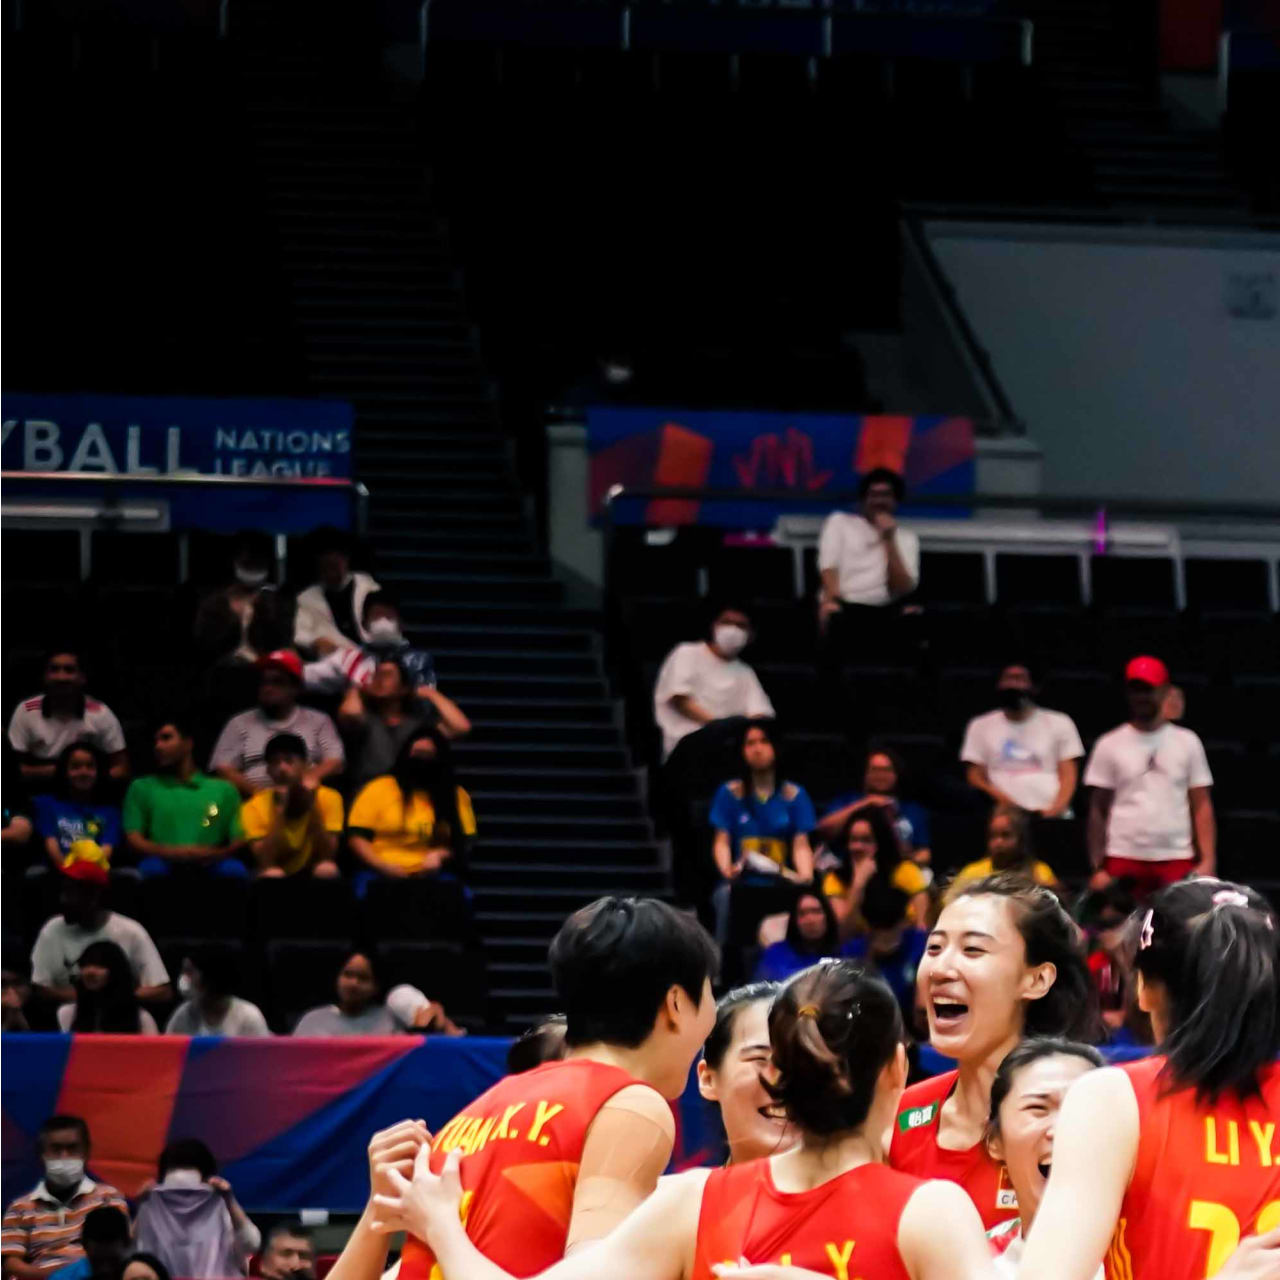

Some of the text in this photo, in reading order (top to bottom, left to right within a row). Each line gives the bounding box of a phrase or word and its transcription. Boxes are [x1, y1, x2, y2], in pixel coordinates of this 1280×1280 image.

[214, 426, 350, 454] NATIONS
[214, 458, 331, 477] LEAGUE
[1206, 1116, 1240, 1166] LI
